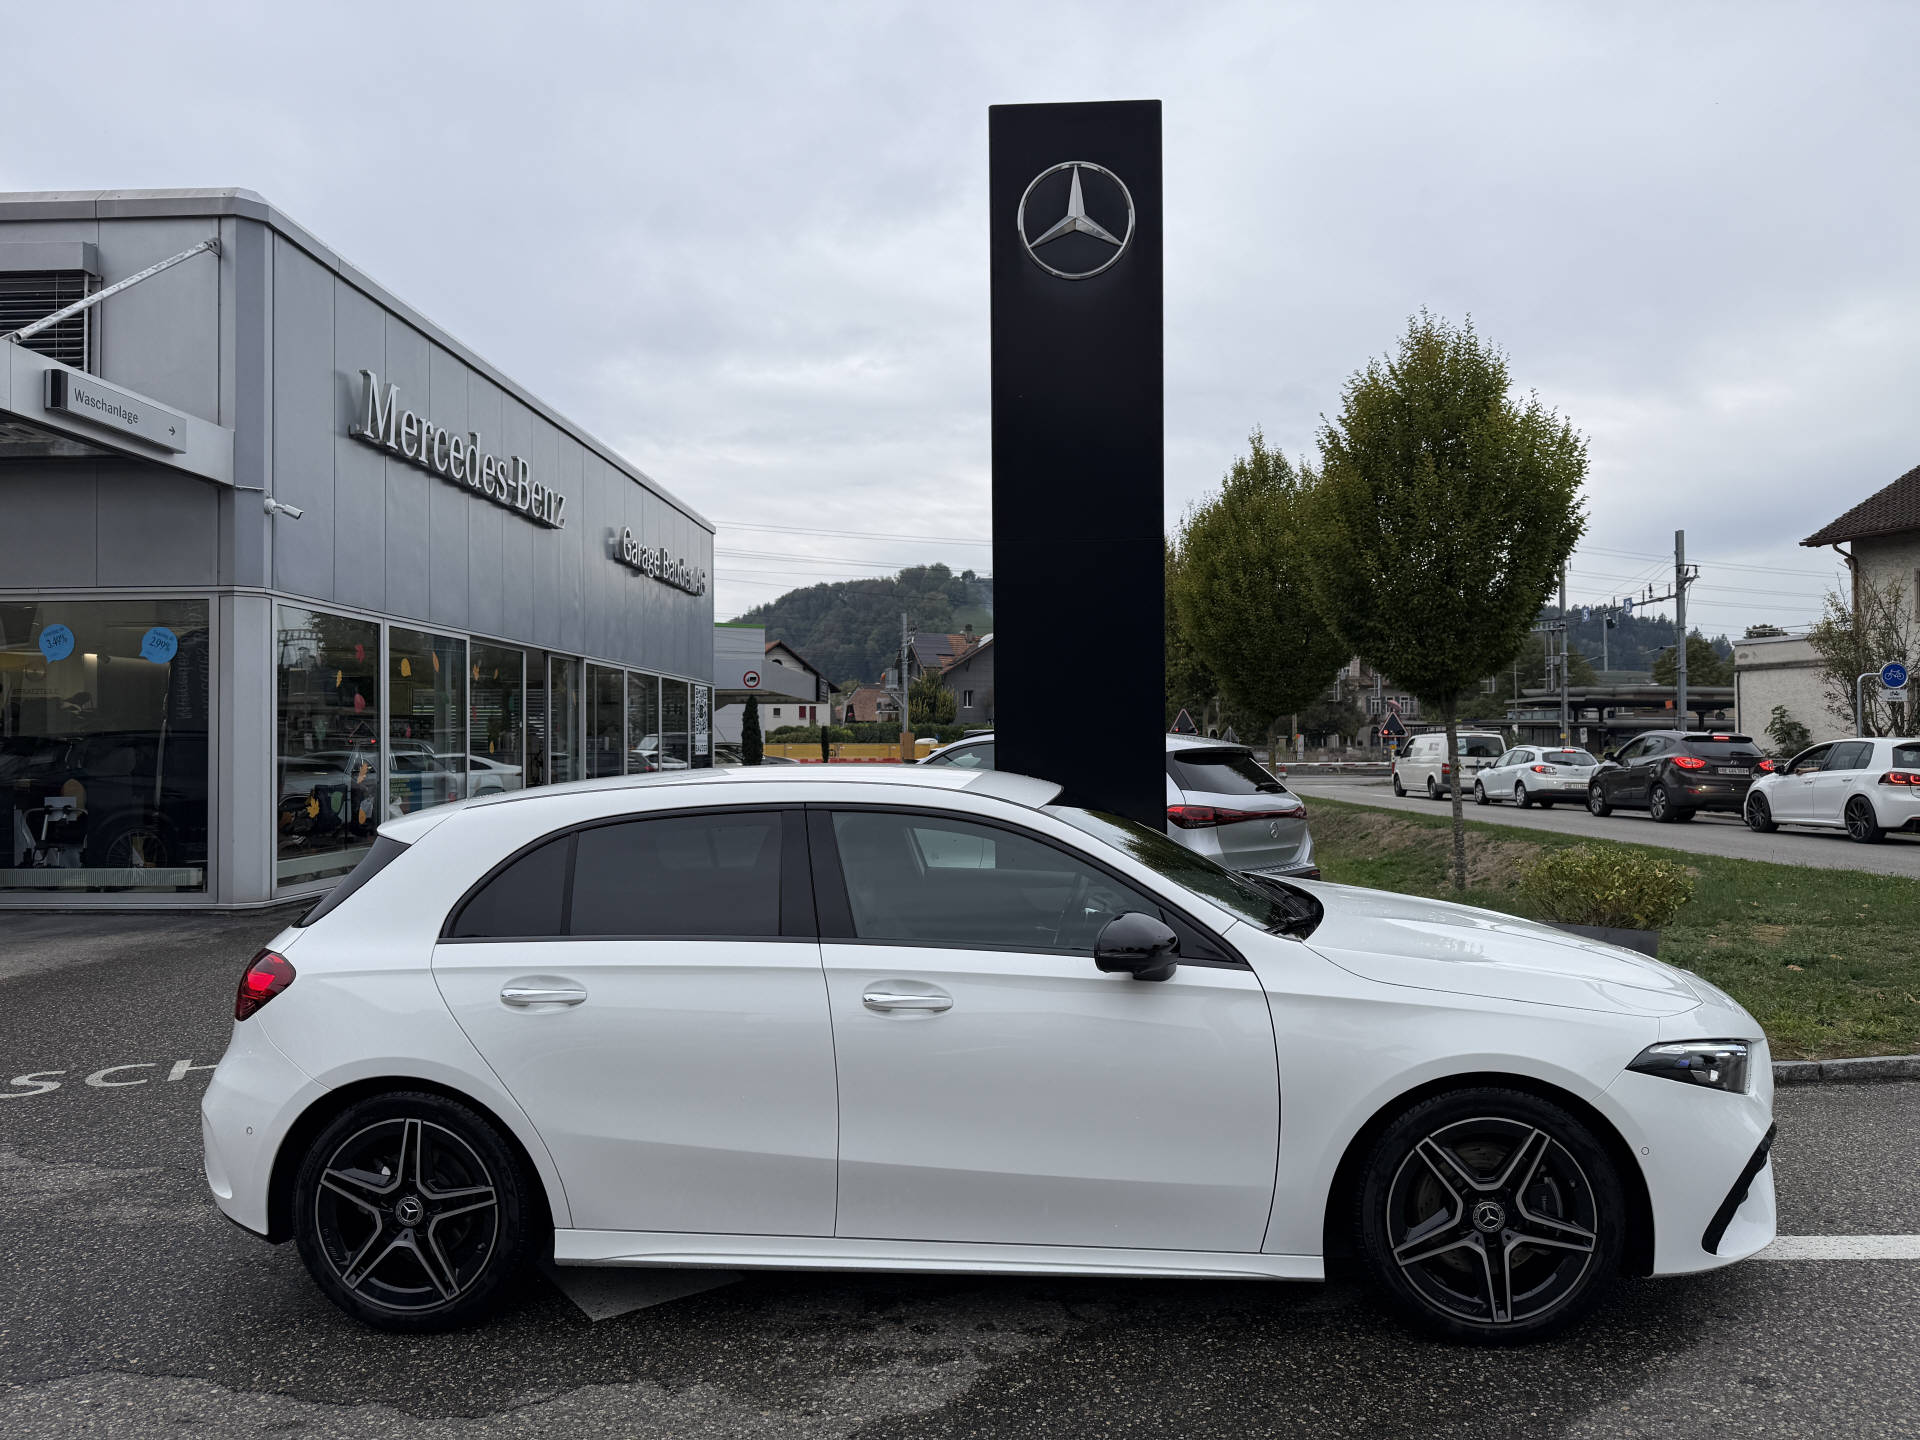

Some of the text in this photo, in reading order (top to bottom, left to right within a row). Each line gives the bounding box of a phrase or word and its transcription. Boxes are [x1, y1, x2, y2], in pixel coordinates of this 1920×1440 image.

[74, 388, 139, 425] Waschanlage
[359, 369, 566, 529] Mercedes-Benz
[623, 526, 660, 577] Garage
